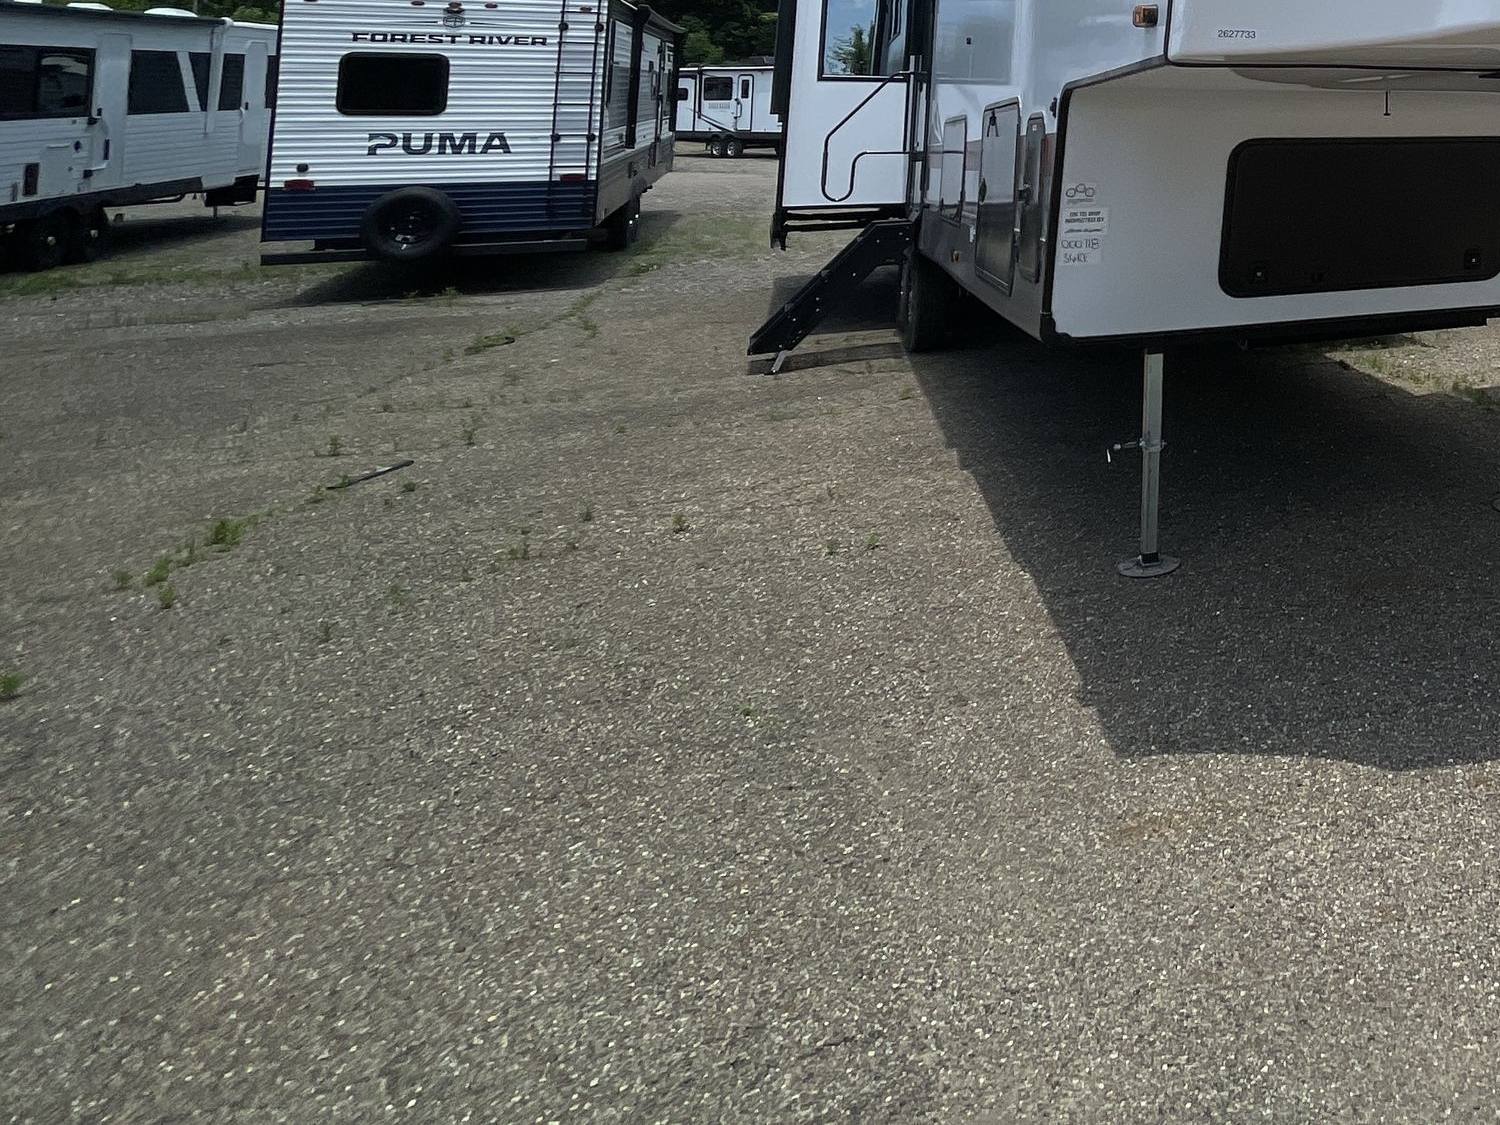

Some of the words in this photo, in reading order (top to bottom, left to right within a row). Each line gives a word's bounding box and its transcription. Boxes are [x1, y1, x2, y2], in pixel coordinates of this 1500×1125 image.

[352, 32, 462, 44] FOREST
[469, 34, 548, 46] RIVER
[1217, 29, 1256, 39] 2627733
[366, 132, 512, 156] PUMA
